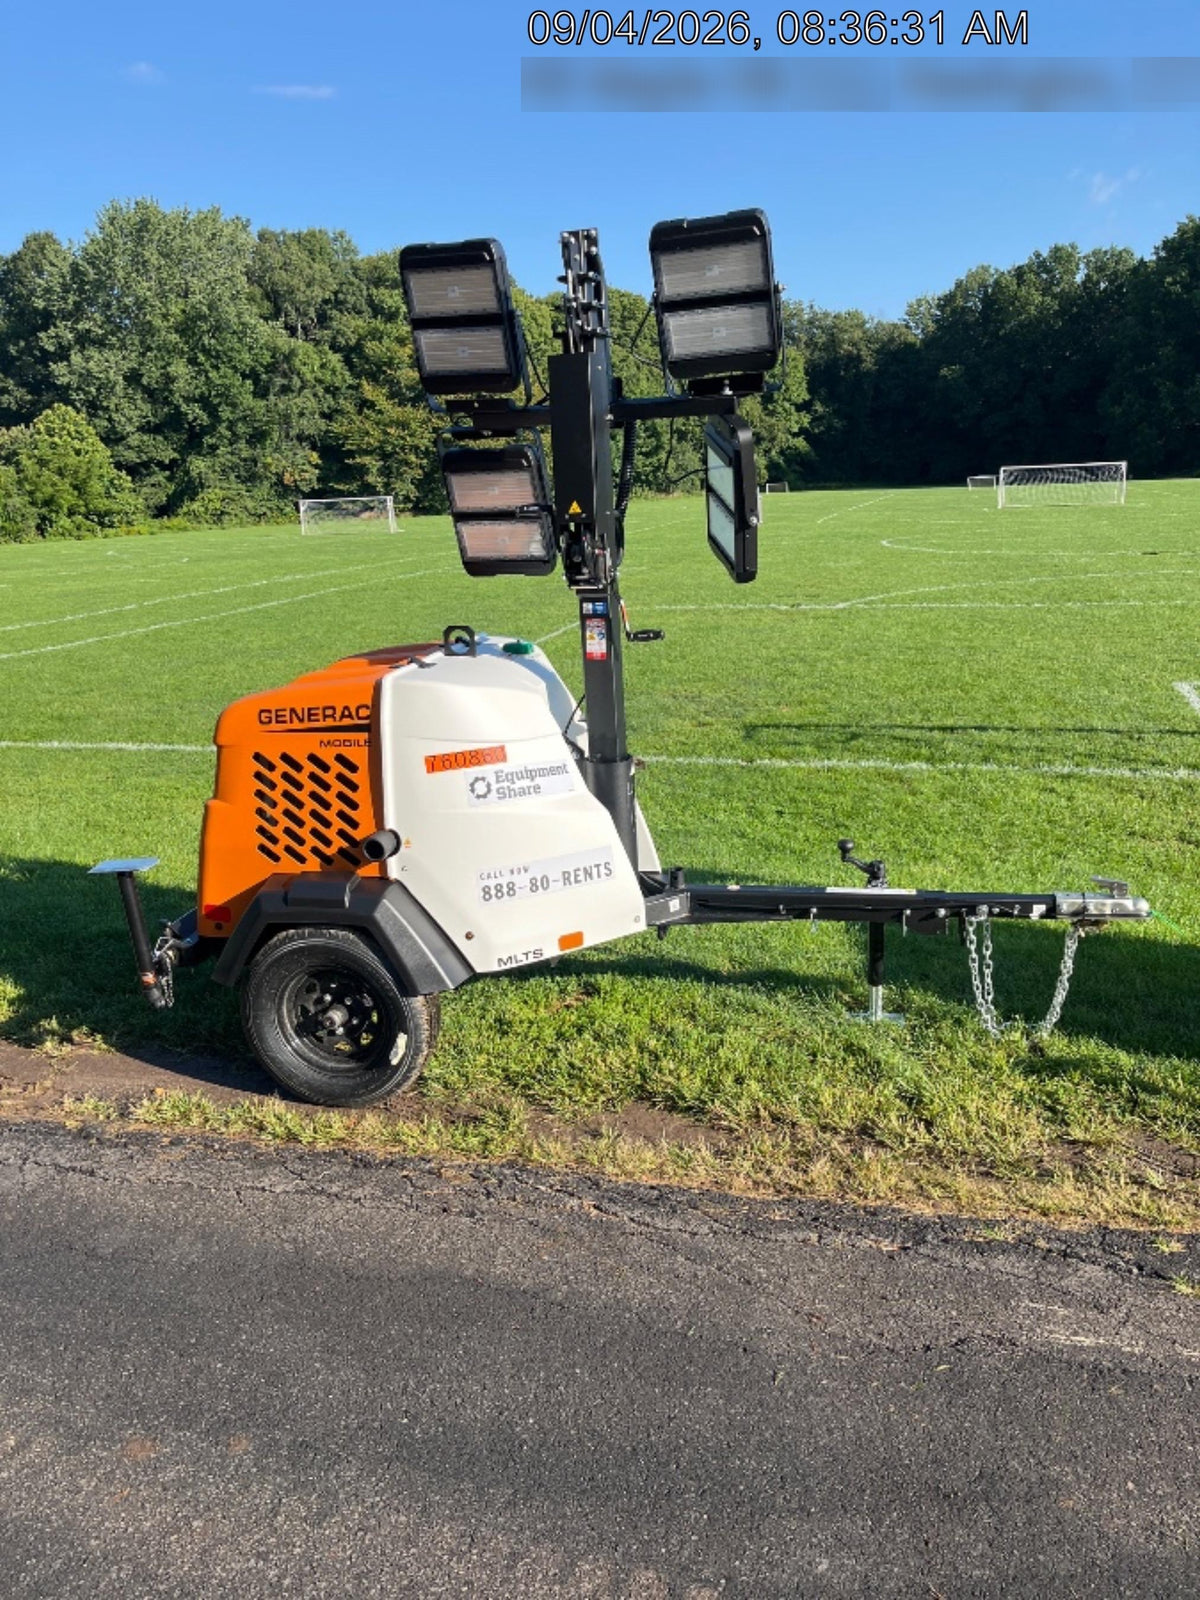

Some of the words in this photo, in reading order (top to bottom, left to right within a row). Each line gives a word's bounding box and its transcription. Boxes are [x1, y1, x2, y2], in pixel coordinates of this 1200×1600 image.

[258, 704, 371, 725] GENERAC
[494, 763, 569, 784] Equipment
[496, 782, 541, 800] Share
[480, 870, 504, 881] CALL
[481, 862, 613, 902] 888-80-RENTS
[497, 948, 543, 967] MLTS
